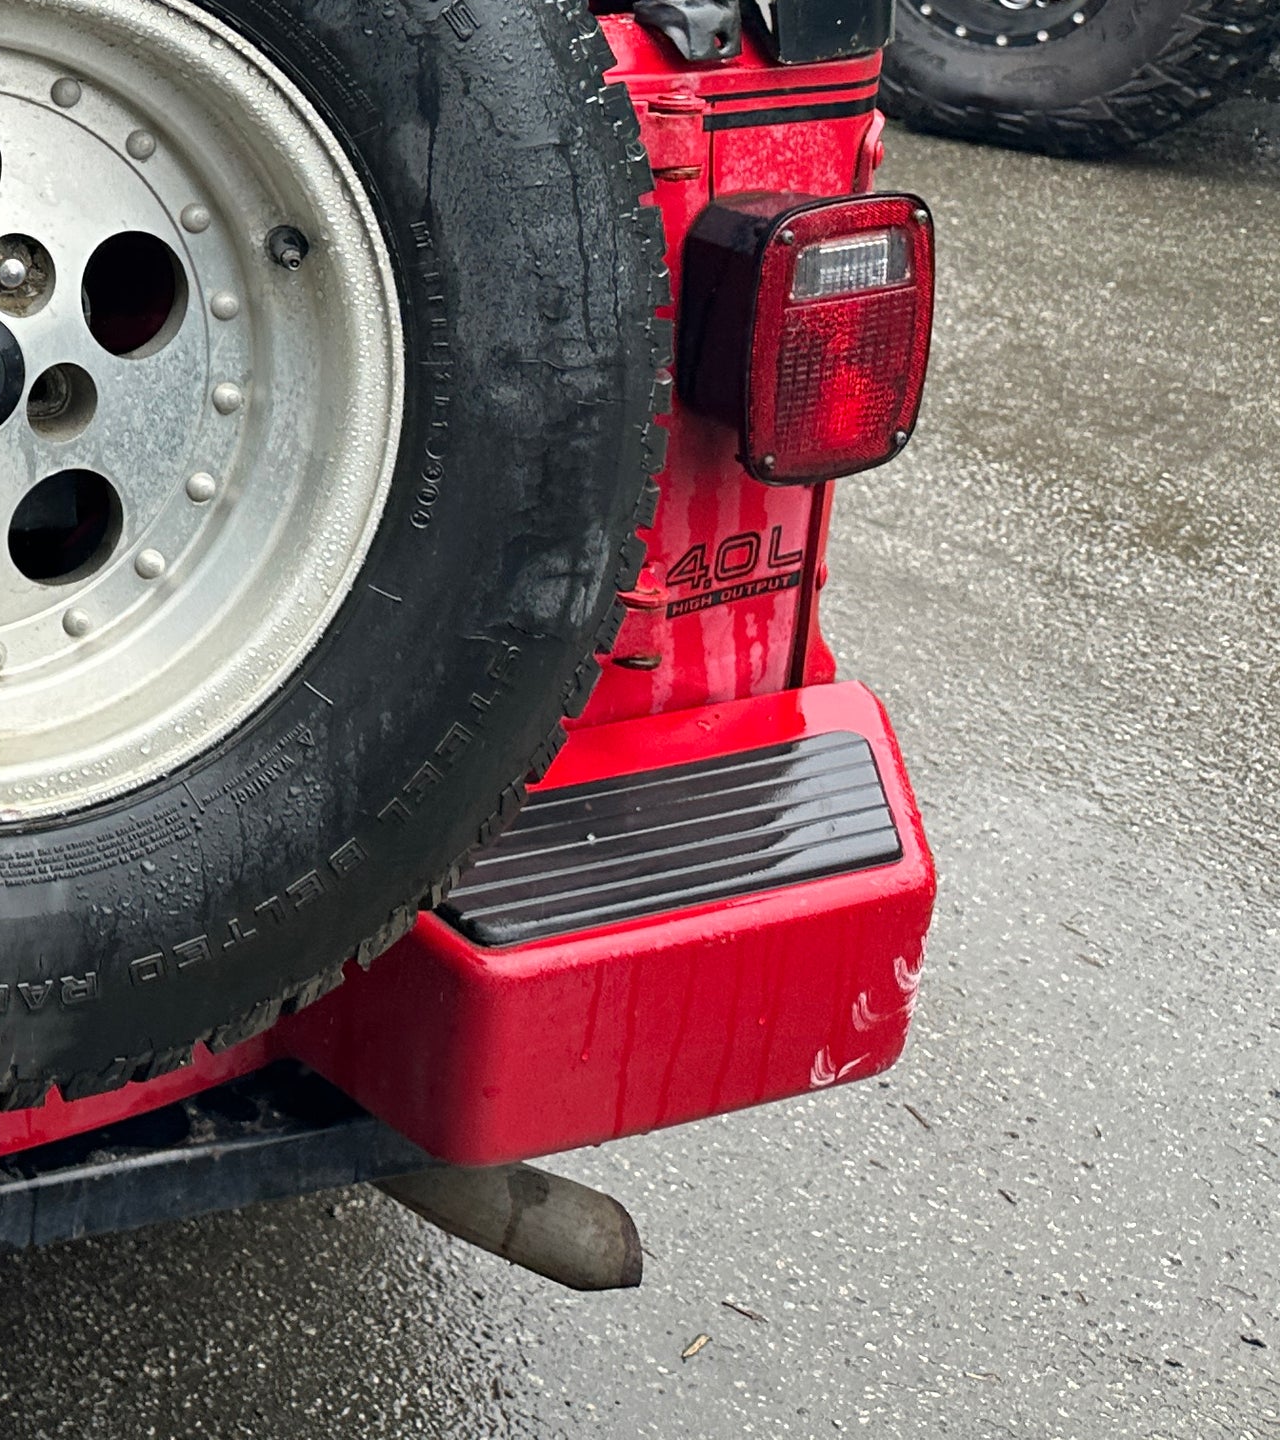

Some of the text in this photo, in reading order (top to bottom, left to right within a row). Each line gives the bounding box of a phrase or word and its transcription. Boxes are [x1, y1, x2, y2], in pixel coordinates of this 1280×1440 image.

[673, 574, 793, 616] HIGH OUTPUT
[376, 636, 527, 828] STEEL
[127, 835, 371, 988] BELTED
